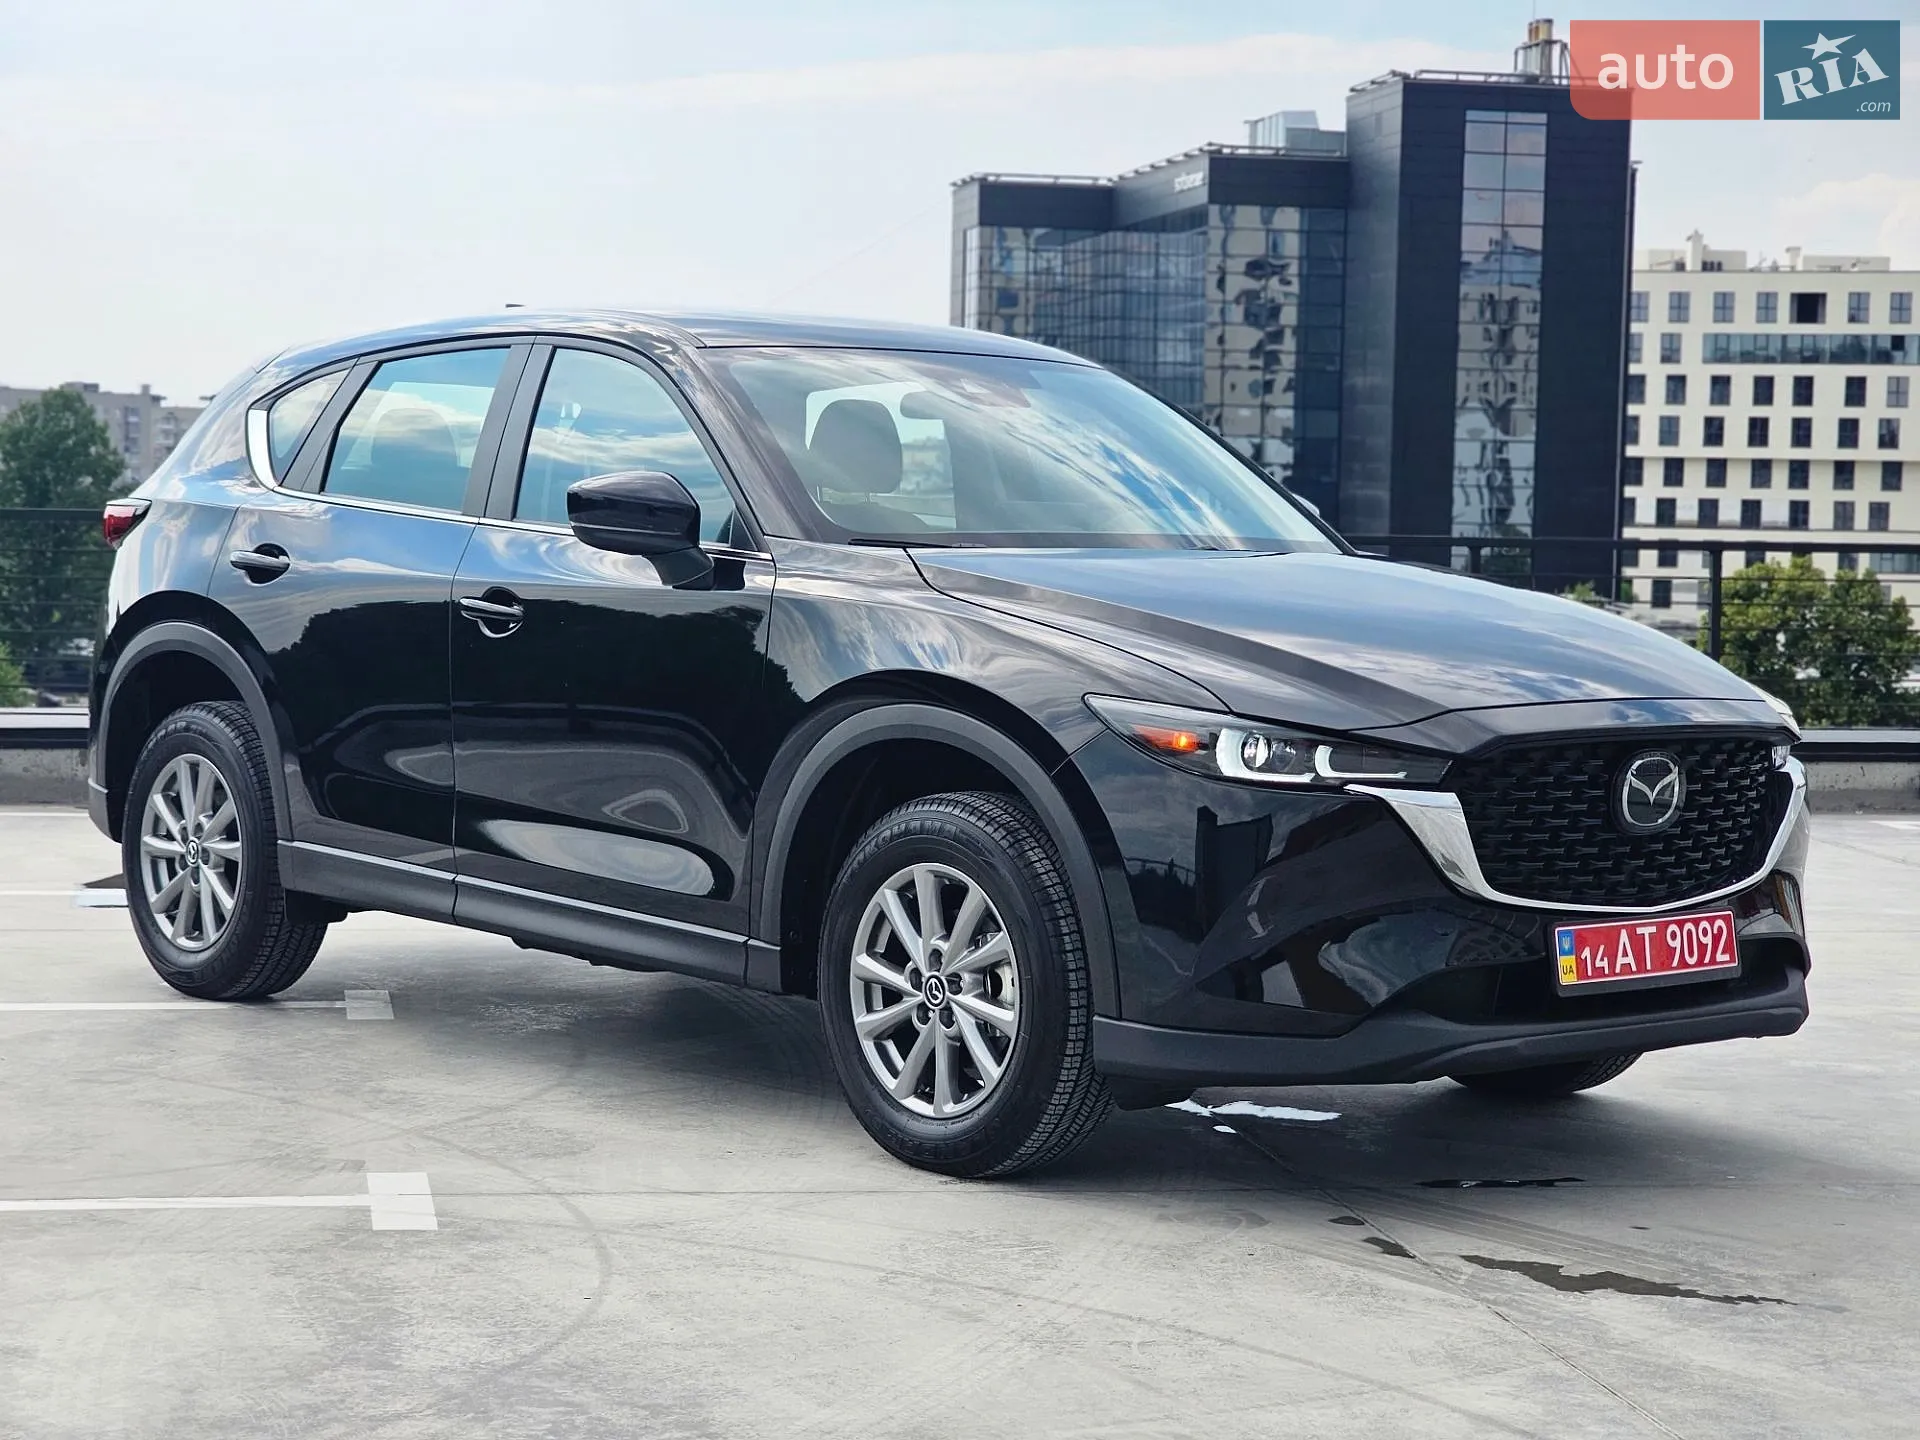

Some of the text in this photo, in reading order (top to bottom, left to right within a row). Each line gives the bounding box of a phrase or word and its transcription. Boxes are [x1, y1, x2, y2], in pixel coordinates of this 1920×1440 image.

[1580, 919, 1731, 977] 14 AT 9092
[1562, 964, 1575, 975] UA
